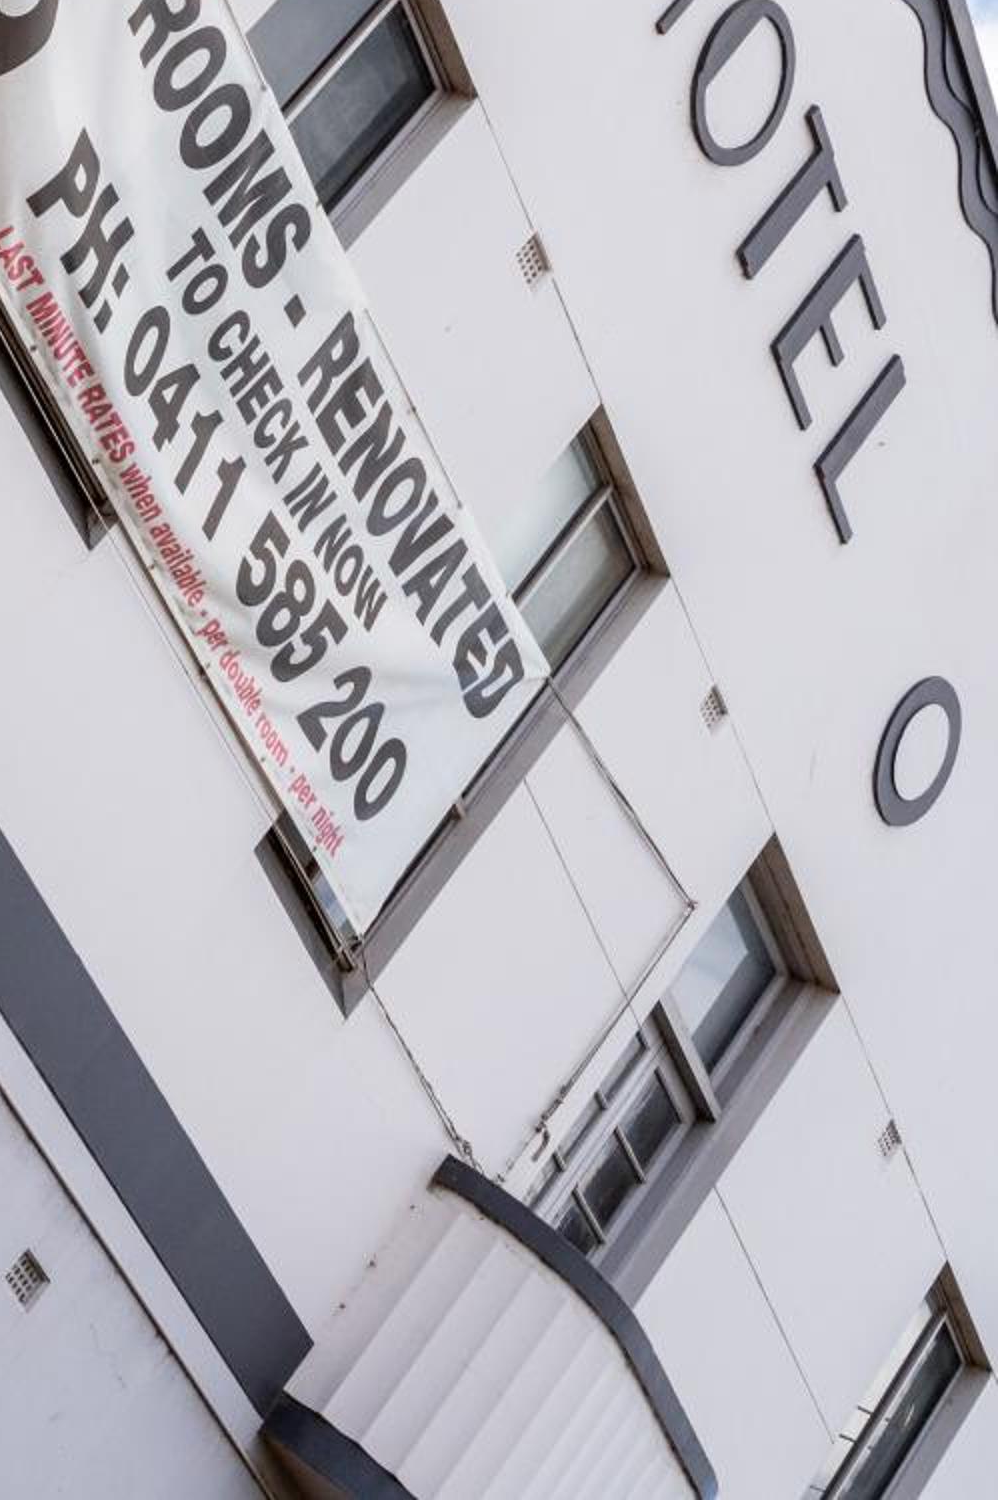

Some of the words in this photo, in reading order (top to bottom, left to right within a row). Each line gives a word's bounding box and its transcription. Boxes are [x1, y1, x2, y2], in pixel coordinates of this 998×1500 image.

[26, 127, 135, 334] PH:
[126, 305, 247, 542] 0411
[235, 509, 349, 683] 585
[296, 664, 409, 821] 200
[26, 291, 94, 387] MINUTE
[78, 383, 136, 464] RATES
[119, 458, 162, 522] when
[150, 518, 206, 607] available
[193, 617, 228, 649] per
[218, 650, 261, 716] double
[255, 712, 289, 767] room
[288, 772, 317, 806] per
[312, 801, 347, 857] night
[165, 228, 228, 316] TO
[208, 310, 309, 484] CHECK
[282, 462, 337, 533] IN
[313, 513, 389, 632] NOW
[297, 310, 526, 720] RENOVATED
